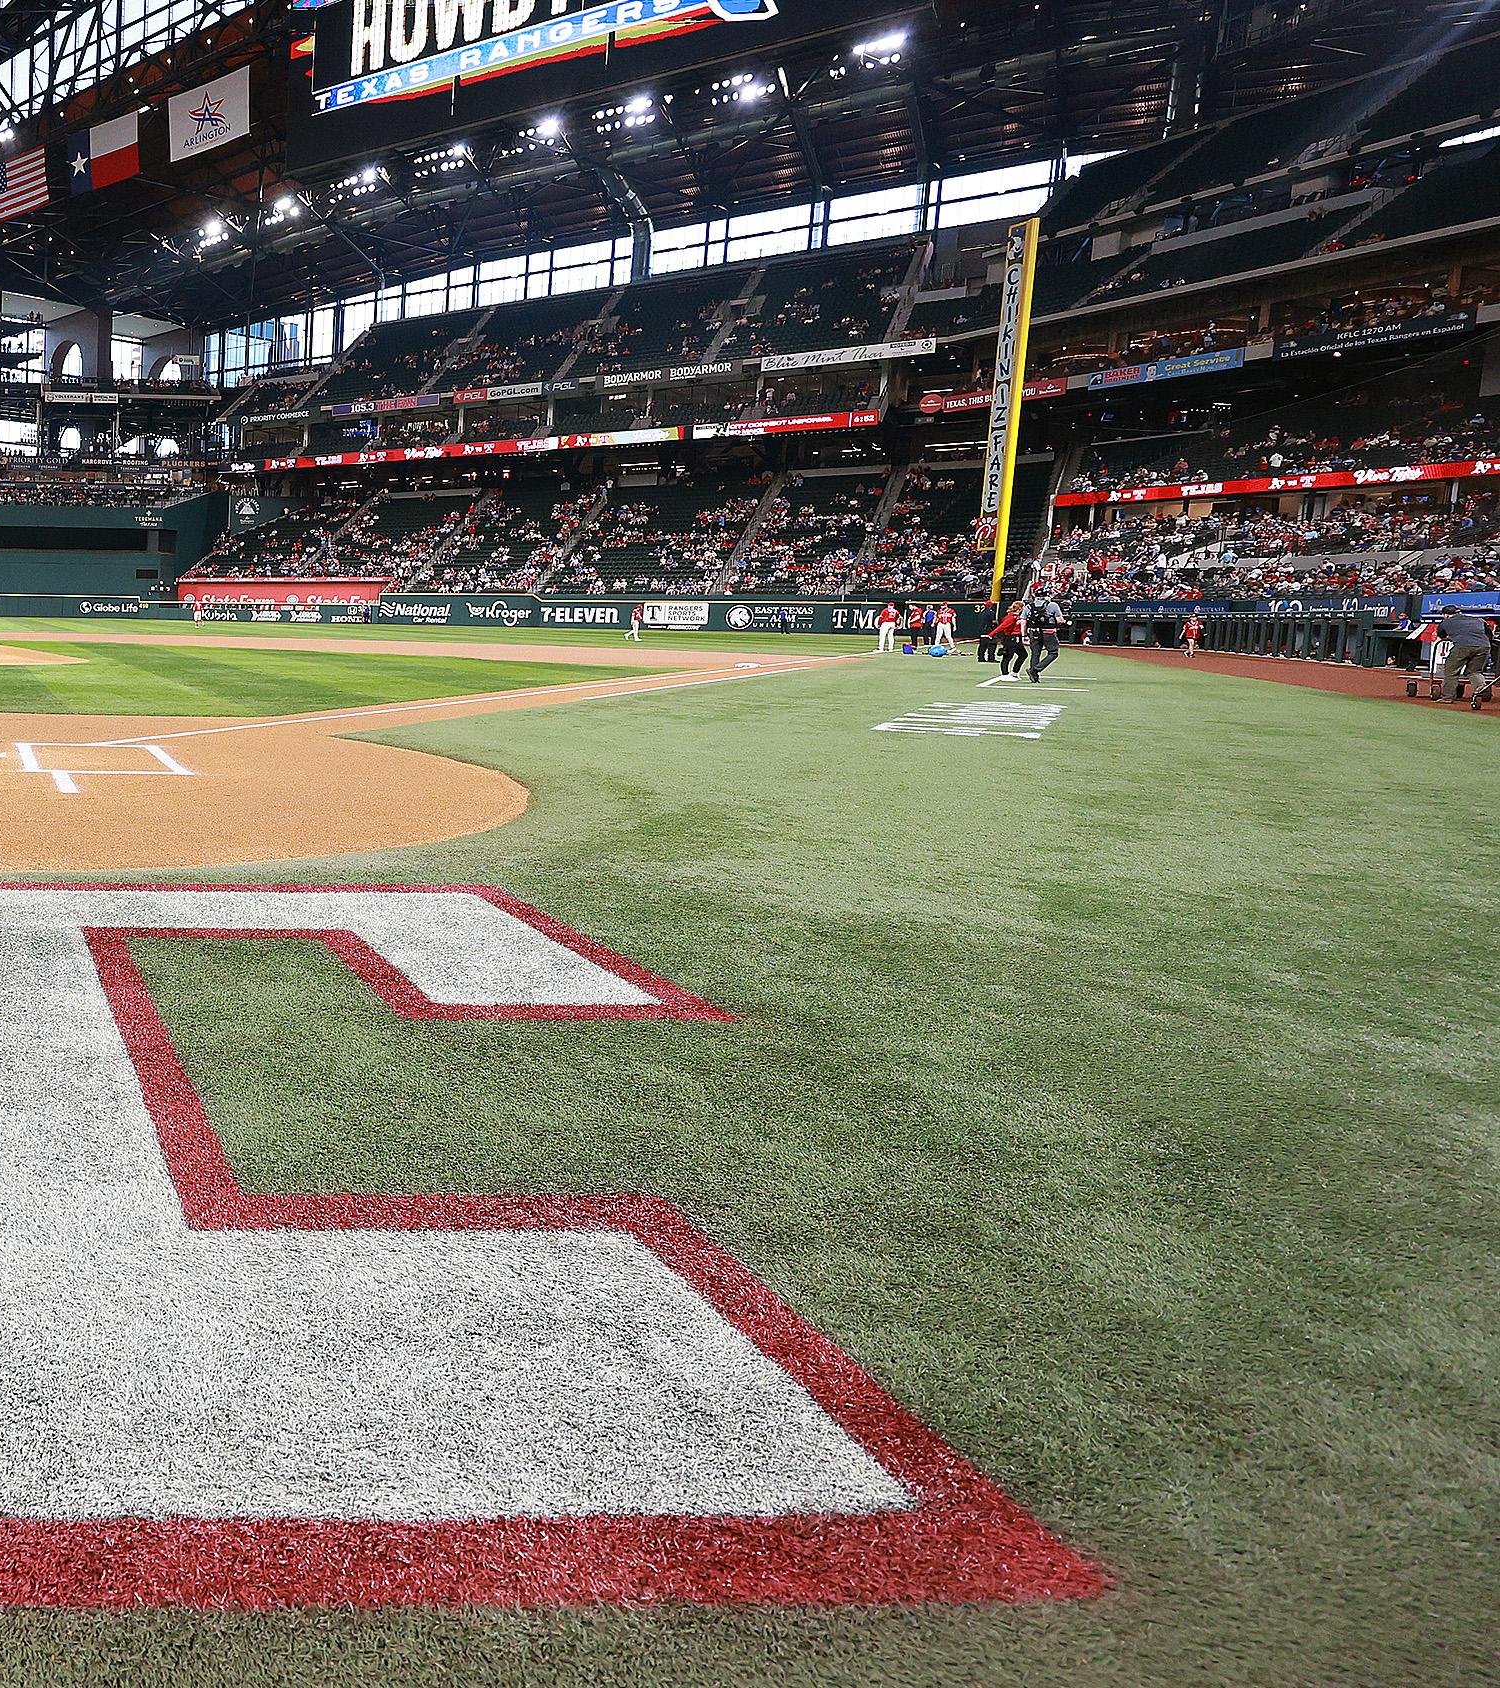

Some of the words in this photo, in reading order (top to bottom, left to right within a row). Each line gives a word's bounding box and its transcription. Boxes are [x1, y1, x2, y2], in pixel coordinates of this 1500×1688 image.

[314, 64, 429, 110] TEXAS
[183, 124, 231, 149] ARLINGTON
[999, 268, 1018, 377] CHIKIN
[1320, 342, 1343, 352] Oficial
[1367, 336, 1388, 345] Texas
[1389, 331, 1420, 342] Rangers
[1432, 323, 1464, 335] Español
[1337, 330, 1360, 340] KFLC
[1362, 326, 1383, 337] 1270
[1385, 323, 1401, 333] AM
[764, 356, 799, 370] Blue
[802, 350, 847, 365] Mint
[852, 347, 885, 360] Thai
[1165, 362, 1191, 371] Great
[1193, 355, 1231, 366] Service
[604, 369, 662, 384] BODYARMOR
[669, 363, 732, 378] BODYARMOR
[1104, 367, 1140, 379] BAKER
[489, 386, 539, 397] GoPGL.com
[552, 381, 576, 391] PGL
[350, 403, 375, 413] 105.3
[968, 396, 984, 406] THIS
[250, 414, 276, 423] PRIORITY
[277, 411, 309, 420] COMMERCE
[987, 434, 1003, 509] FARE
[92, 603, 120, 612] Globe
[121, 603, 138, 612] Life
[202, 610, 237, 620] Kubota
[486, 601, 532, 626] Kroger
[781, 607, 814, 615] TEXAS
